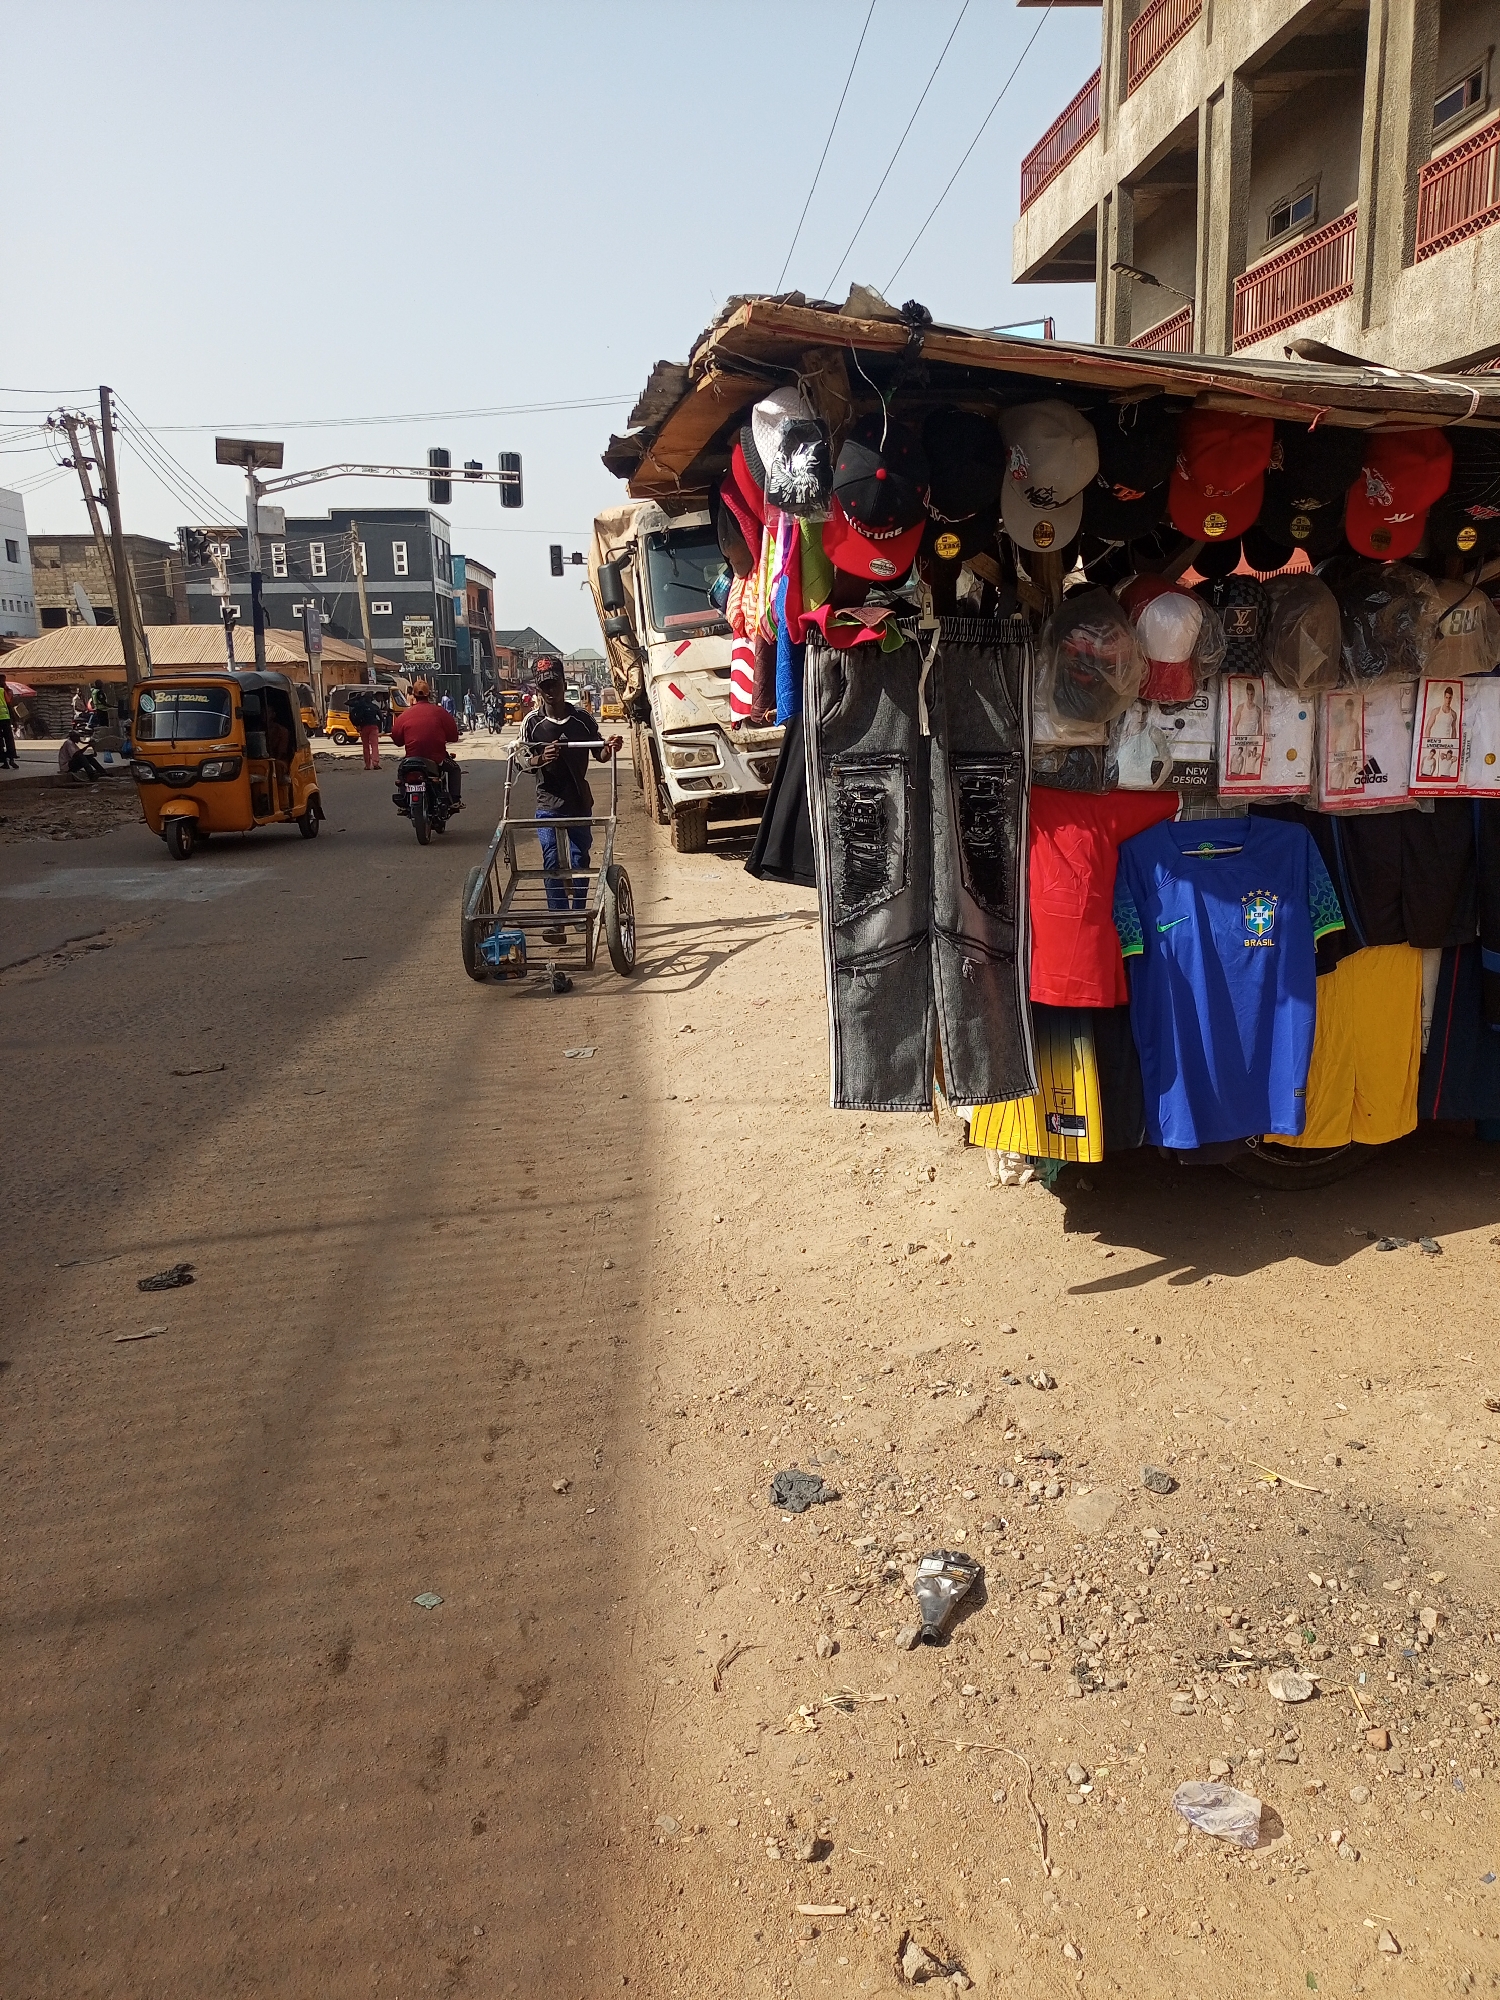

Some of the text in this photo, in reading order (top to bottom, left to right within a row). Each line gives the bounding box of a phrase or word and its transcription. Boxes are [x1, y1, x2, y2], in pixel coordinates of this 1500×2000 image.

[1233, 609, 1251, 627] LV
[1185, 767, 1209, 775] NEW
[1172, 776, 1208, 785] DESIGN
[1353, 773, 1388, 785] adidas
[1244, 938, 1275, 947] BRASIL
